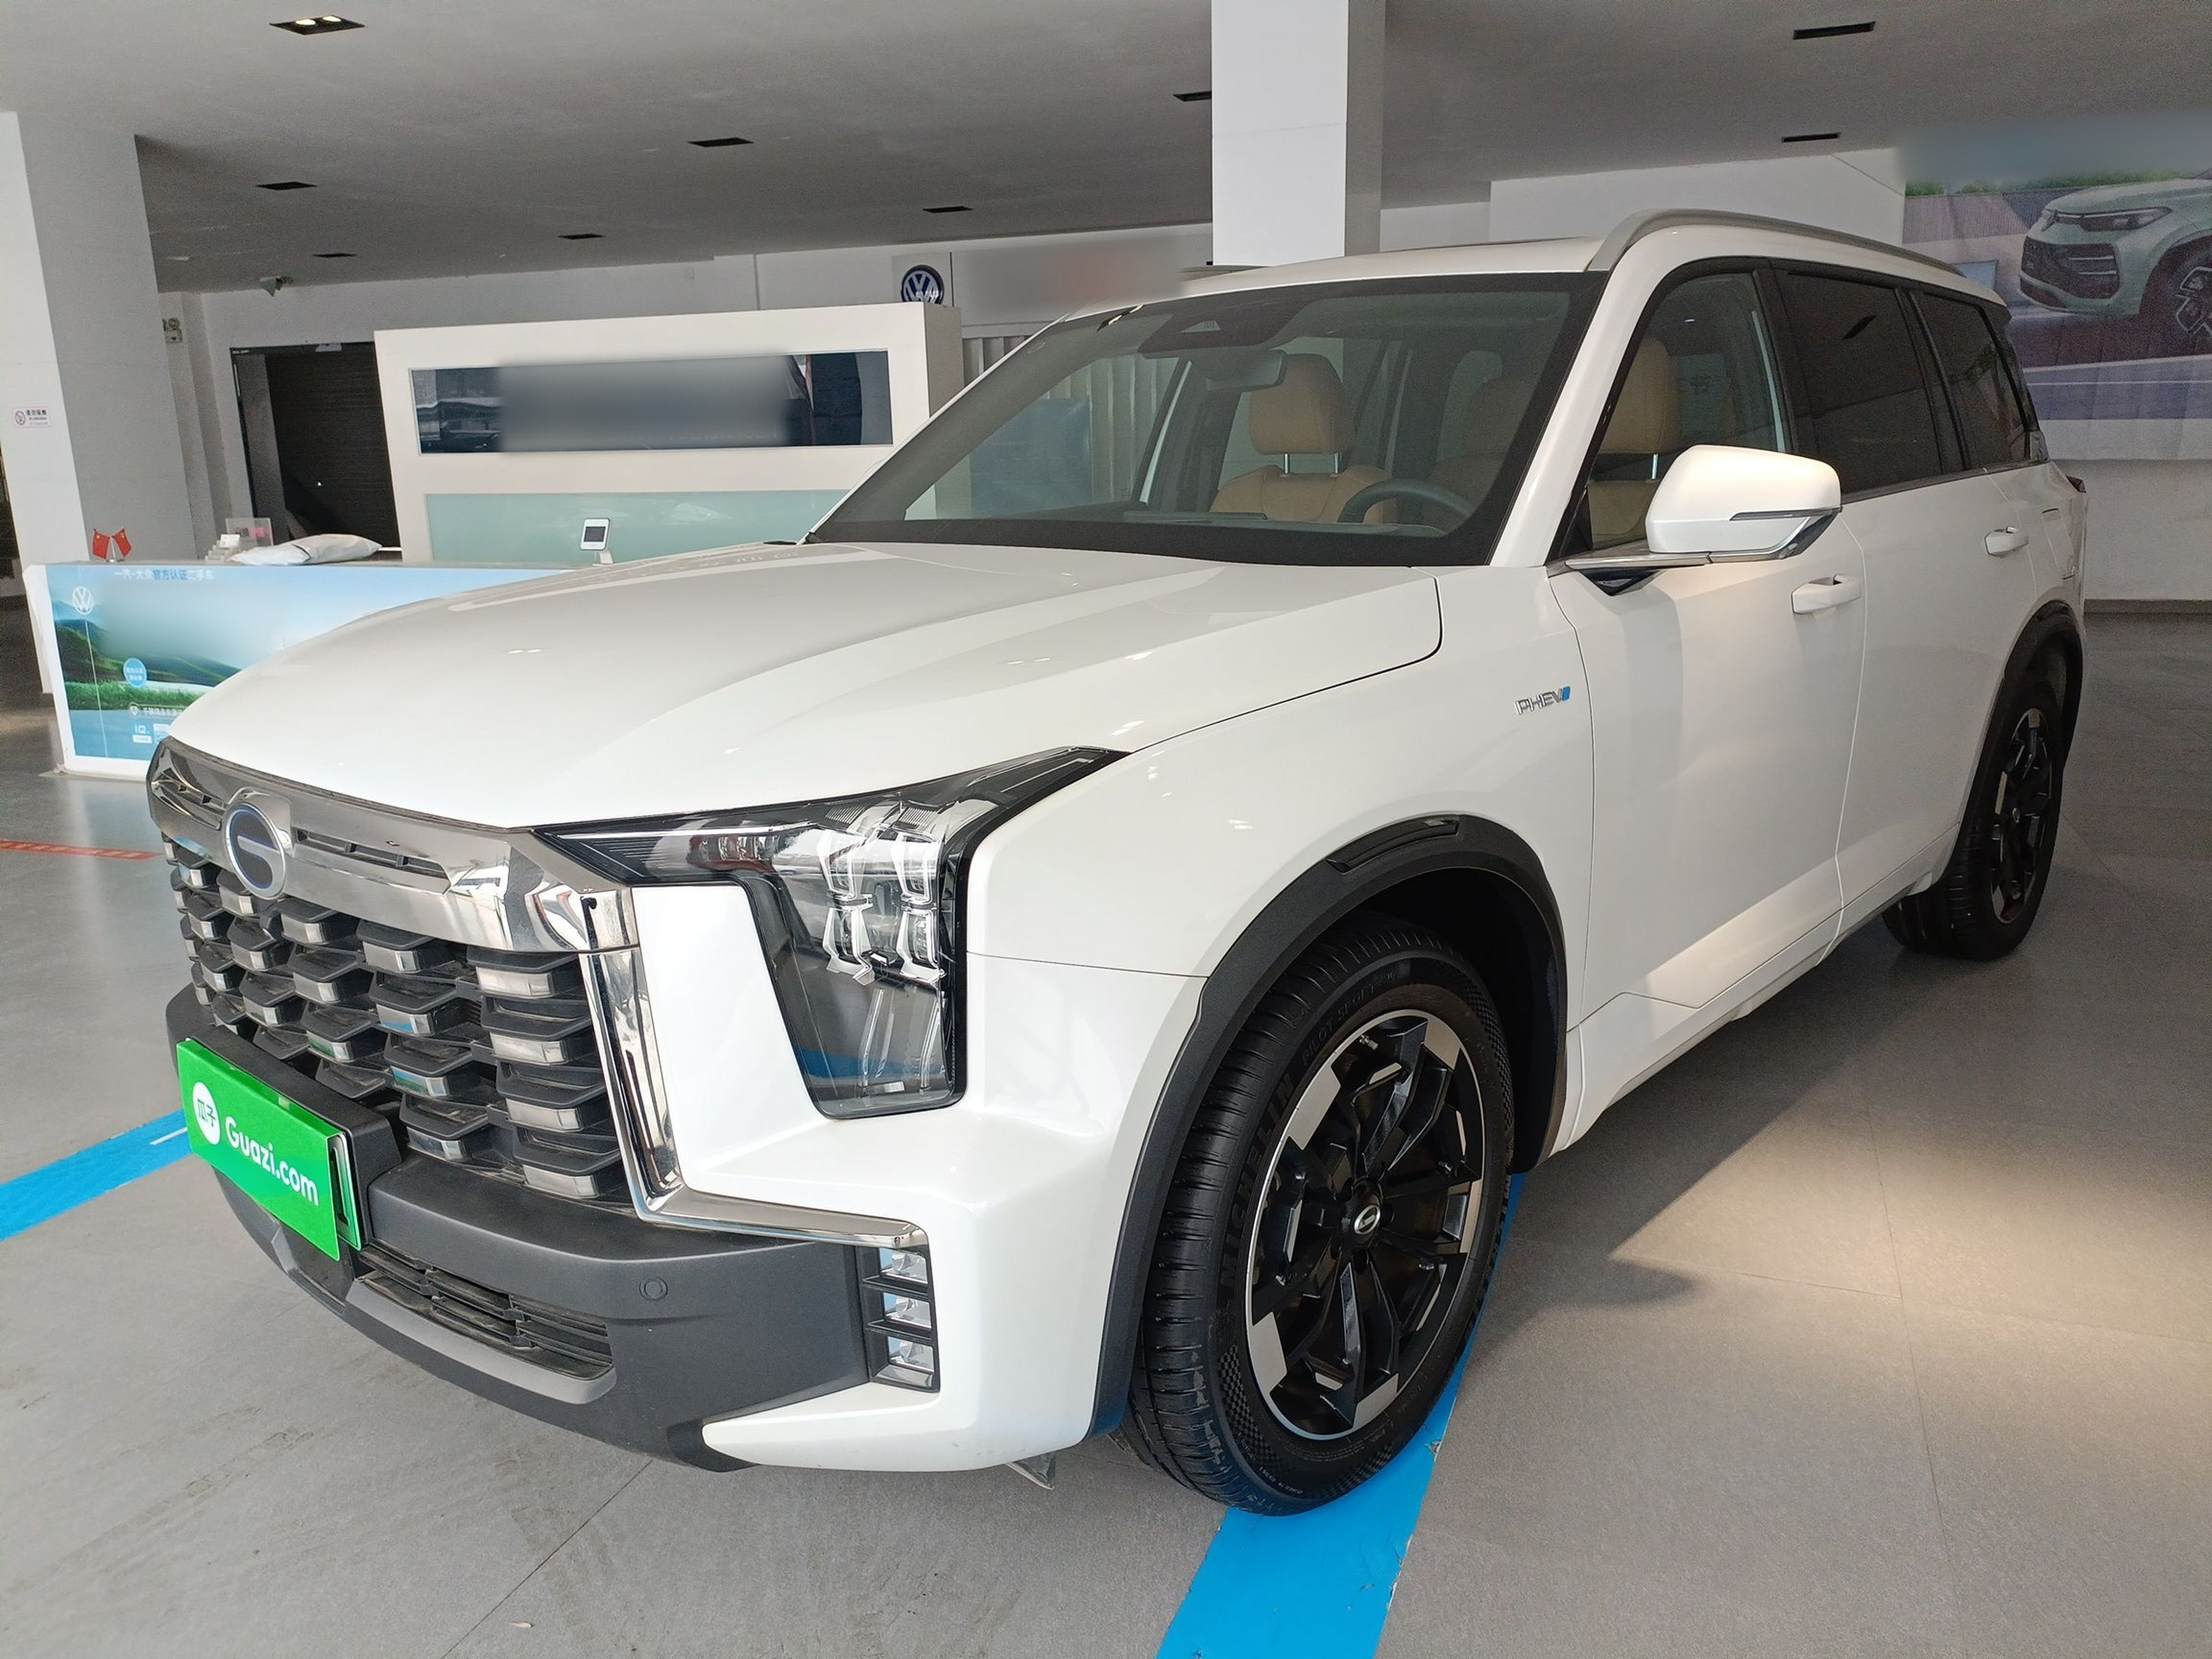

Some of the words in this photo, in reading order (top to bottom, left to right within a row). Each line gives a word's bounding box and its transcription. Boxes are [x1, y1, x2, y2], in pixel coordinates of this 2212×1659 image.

[1514, 685, 1563, 715] PHEV
[197, 1098, 216, 1127] 瓜子
[225, 1116, 319, 1206] Guazi.com
[1219, 1072, 1296, 1286] MICHELIN
[1302, 1018, 1335, 1067] PILOT
